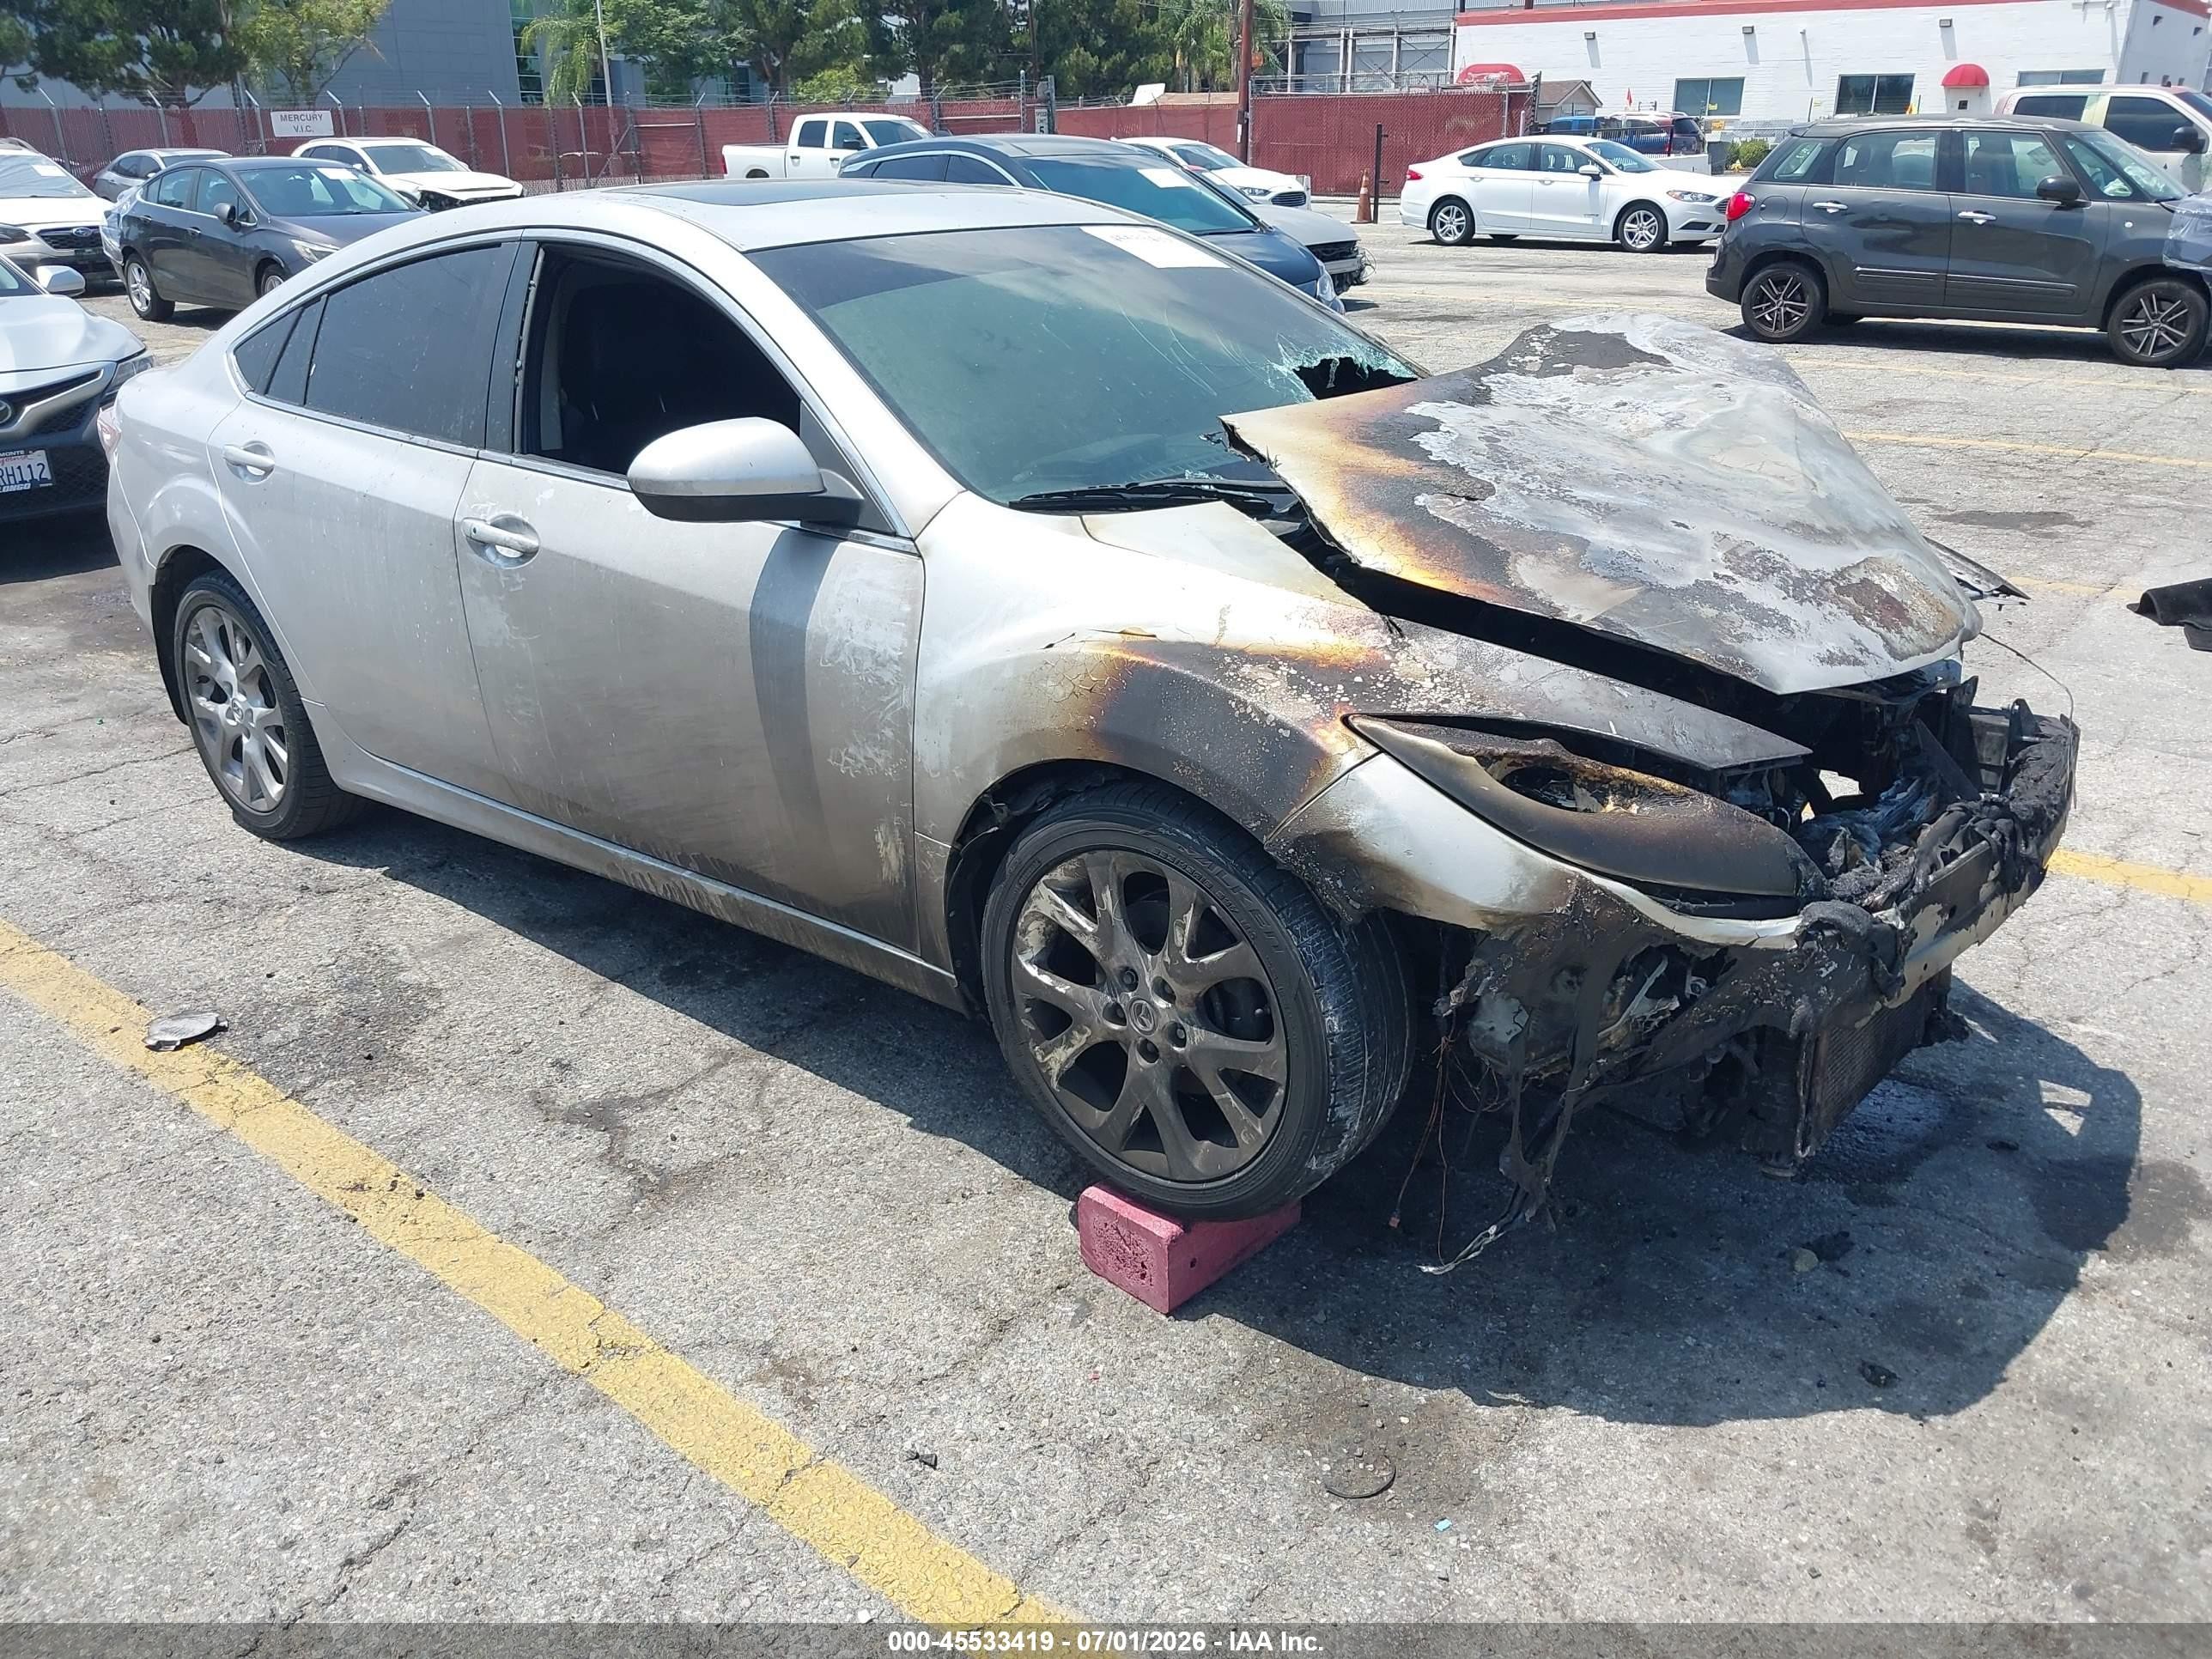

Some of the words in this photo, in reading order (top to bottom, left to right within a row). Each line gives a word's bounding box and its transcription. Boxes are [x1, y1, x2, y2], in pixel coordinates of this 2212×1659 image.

[280, 113, 323, 122] MERCURY
[293, 125, 315, 133] V.I.C.
[1039, 125, 1045, 134] 5
